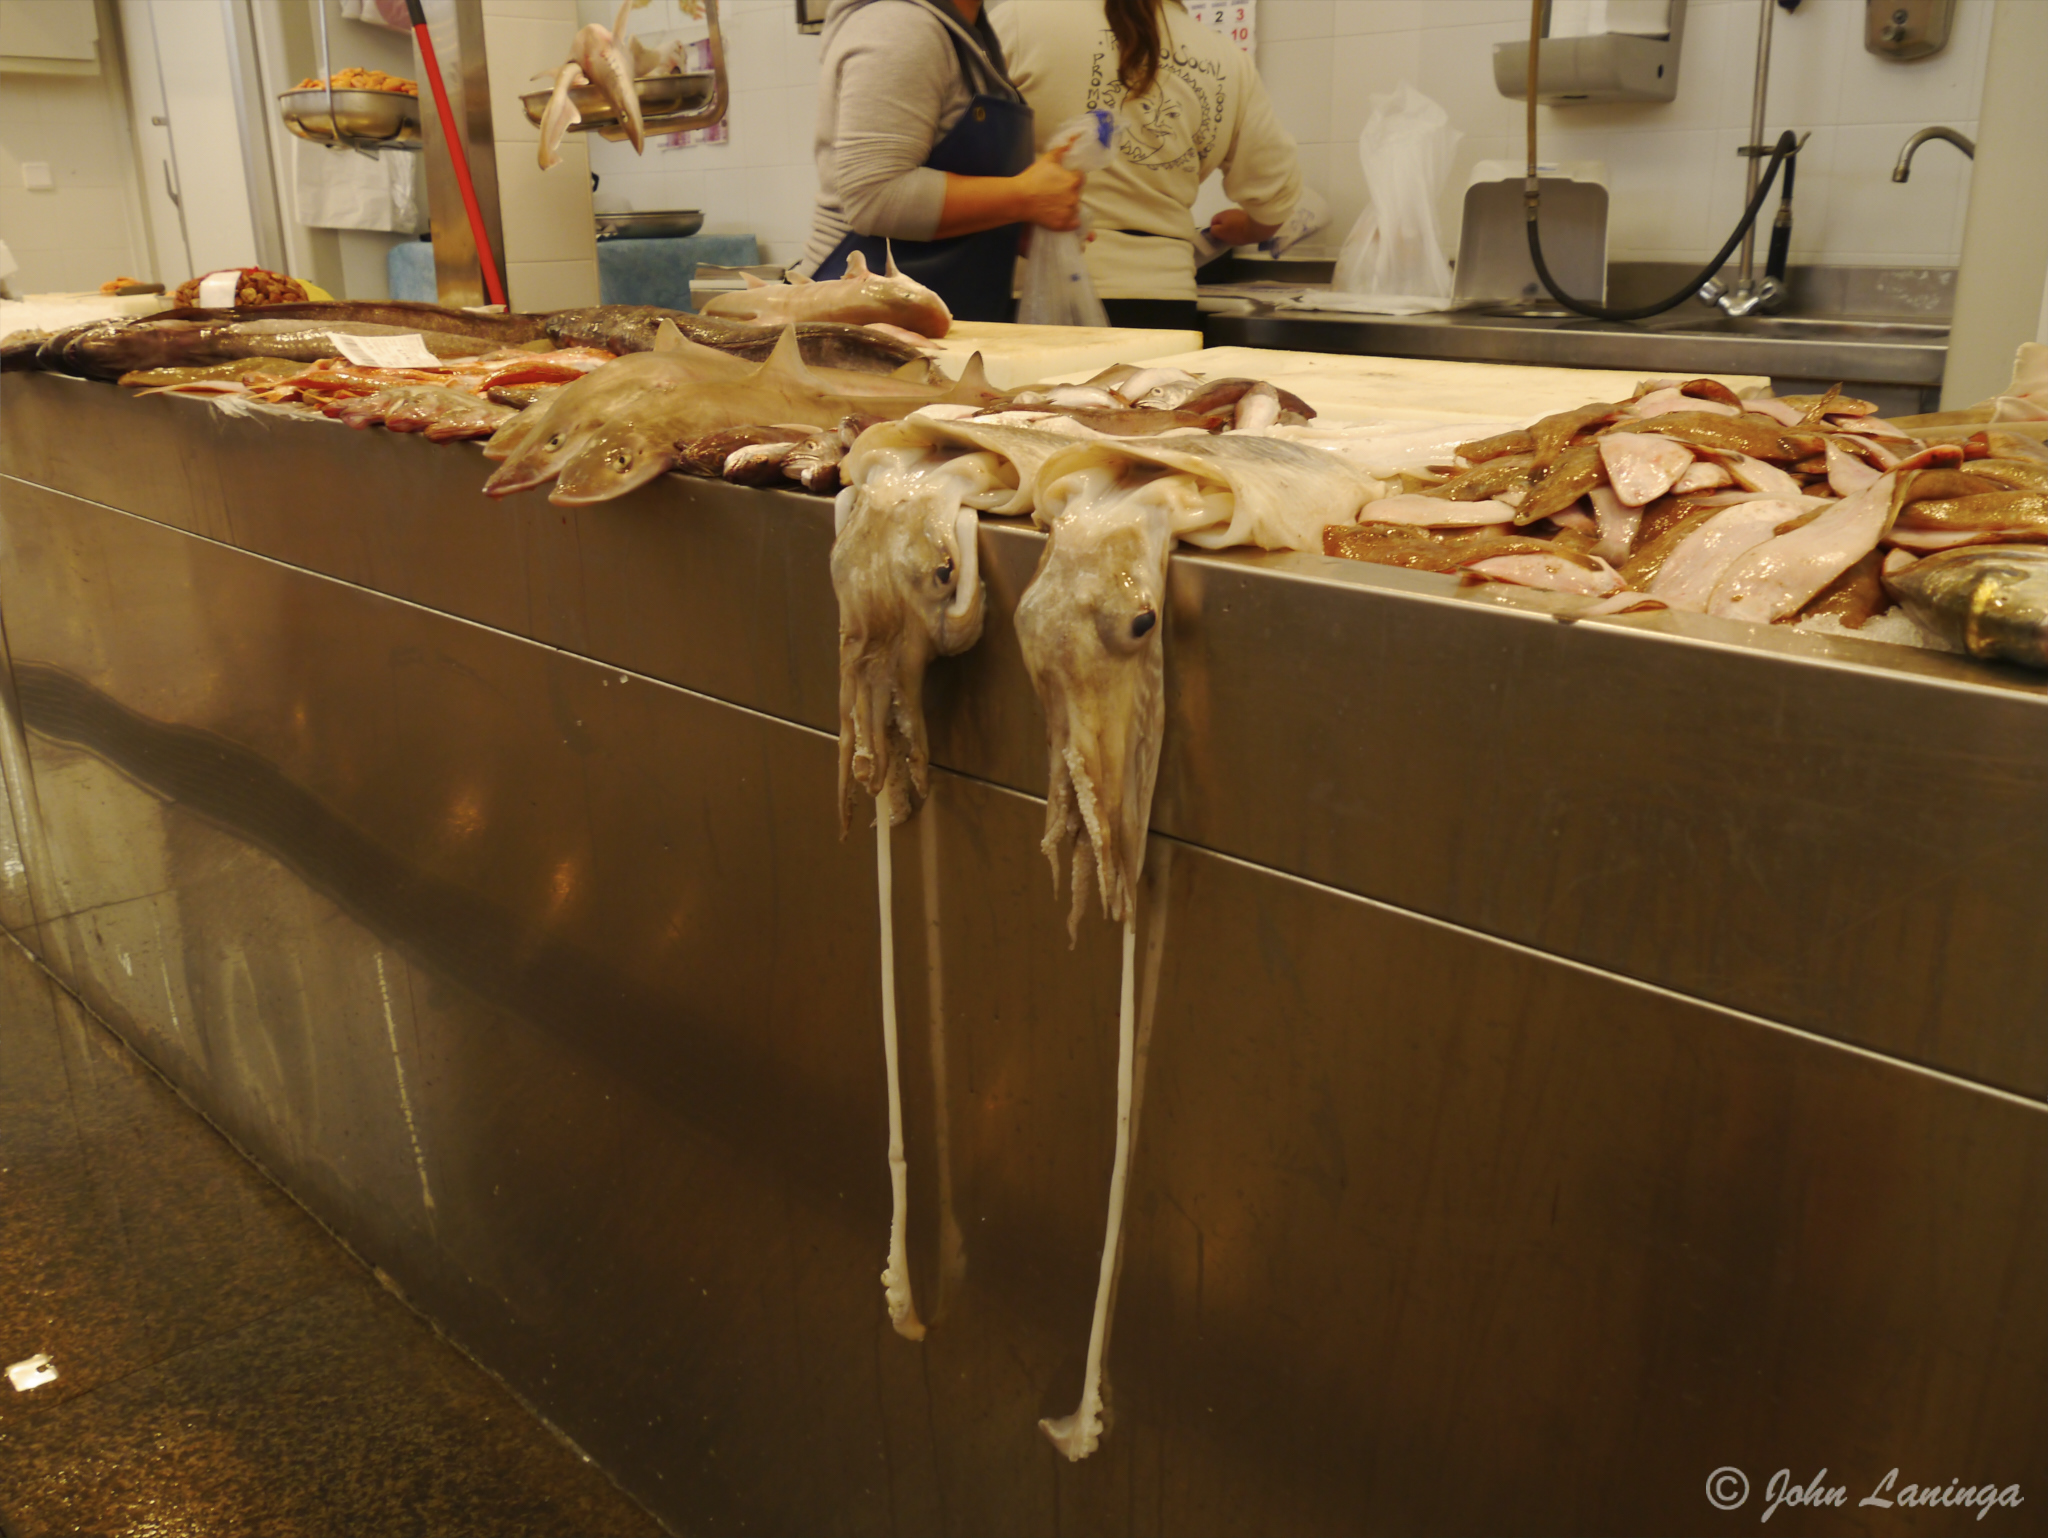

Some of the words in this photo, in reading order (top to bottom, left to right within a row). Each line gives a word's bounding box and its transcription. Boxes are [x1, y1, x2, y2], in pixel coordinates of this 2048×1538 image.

[1215, 10, 1224, 23] 2
[1236, 8, 1245, 21] 3
[1231, 27, 1249, 41] 10
[1086, 52, 1105, 110] PROMO
